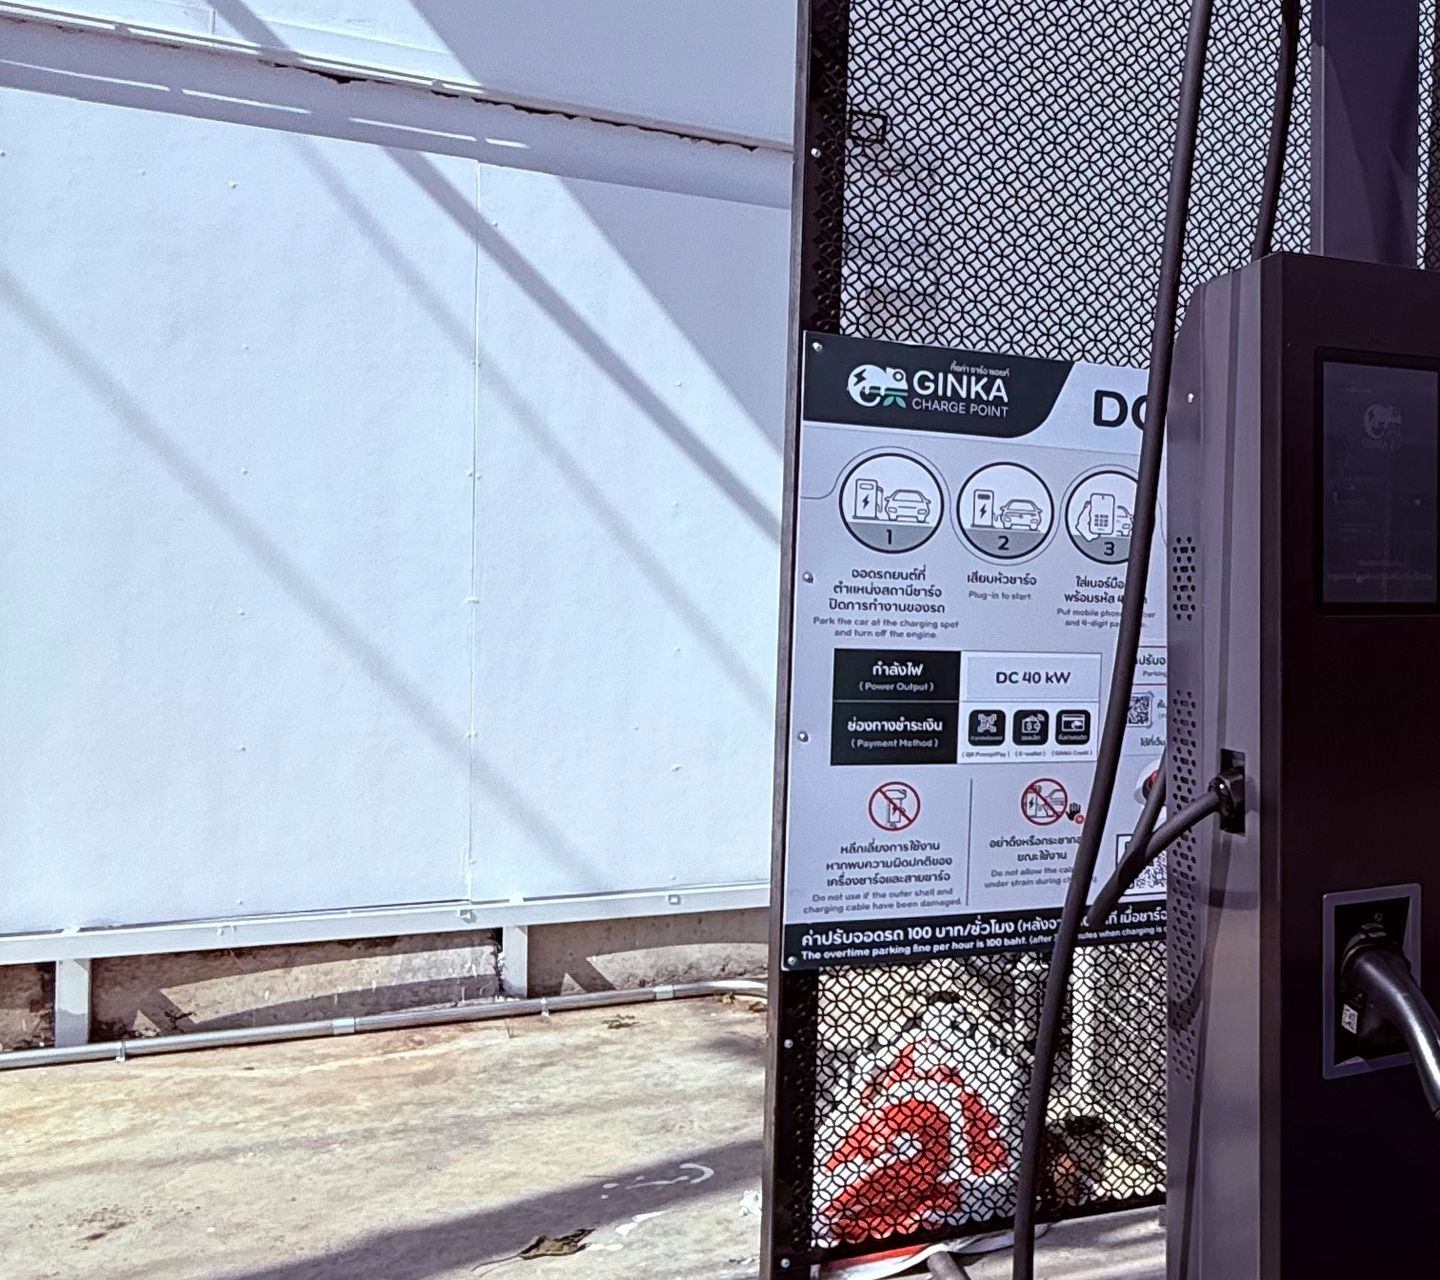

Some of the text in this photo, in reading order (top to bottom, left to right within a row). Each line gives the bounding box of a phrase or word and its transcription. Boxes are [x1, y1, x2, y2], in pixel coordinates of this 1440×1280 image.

[912, 370, 1009, 403] GINKA
[912, 397, 1009, 419] CHARGE POINT
[886, 529, 893, 545] 1
[997, 536, 1009, 551] 2
[1103, 541, 1115, 556] 3
[851, 564, 926, 581] จอดรถยนต์ที่
[833, 580, 942, 598] ตำแหน่งสถานีชาร์จ
[1075, 575, 1126, 589] ใส่เบอร์มือ
[968, 590, 999, 601] Plug-in
[1001, 591, 1010, 600] to
[828, 597, 945, 614] ปิดการทำงานของรถ
[1100, 610, 1122, 618] phon
[813, 616, 835, 625] Park
[837, 617, 852, 626] the
[871, 618, 881, 626] at
[883, 618, 898, 627] the
[899, 619, 938, 630] charging
[940, 621, 959, 631] spot
[834, 628, 852, 636] and
[854, 629, 873, 637] turn
[874, 629, 887, 637] off
[889, 630, 904, 638] the
[872, 660, 924, 676] กำลังไฟ
[995, 671, 1071, 684] DC 40 kW
[847, 716, 943, 732] ช่องทางชำระเงิน
[991, 869, 1003, 877] Do
[1035, 878, 1061, 886] during
[812, 887, 953, 902] Do not use if the outer shell and
[803, 904, 844, 915] charging
[845, 902, 871, 911] cable
[872, 901, 894, 910] have
[896, 899, 919, 909] been
[801, 928, 904, 947] ค่าปรับจอดรถ
[907, 926, 932, 940] 100
[935, 915, 1015, 938] บาท/ชั่วโมง
[801, 950, 821, 960] The
[823, 948, 870, 960] overtime
[872, 945, 911, 958] parking
[912, 943, 931, 953] fine
[933, 943, 950, 954] per
[951, 939, 975, 950] hour
[976, 939, 985, 948] is
[986, 937, 1002, 947] 100
[1003, 936, 1027, 946] baht.
[1029, 934, 1052, 945] (after
[1099, 929, 1121, 938] when
[1122, 926, 1155, 937] charging
[1155, 925, 1163, 933] is
